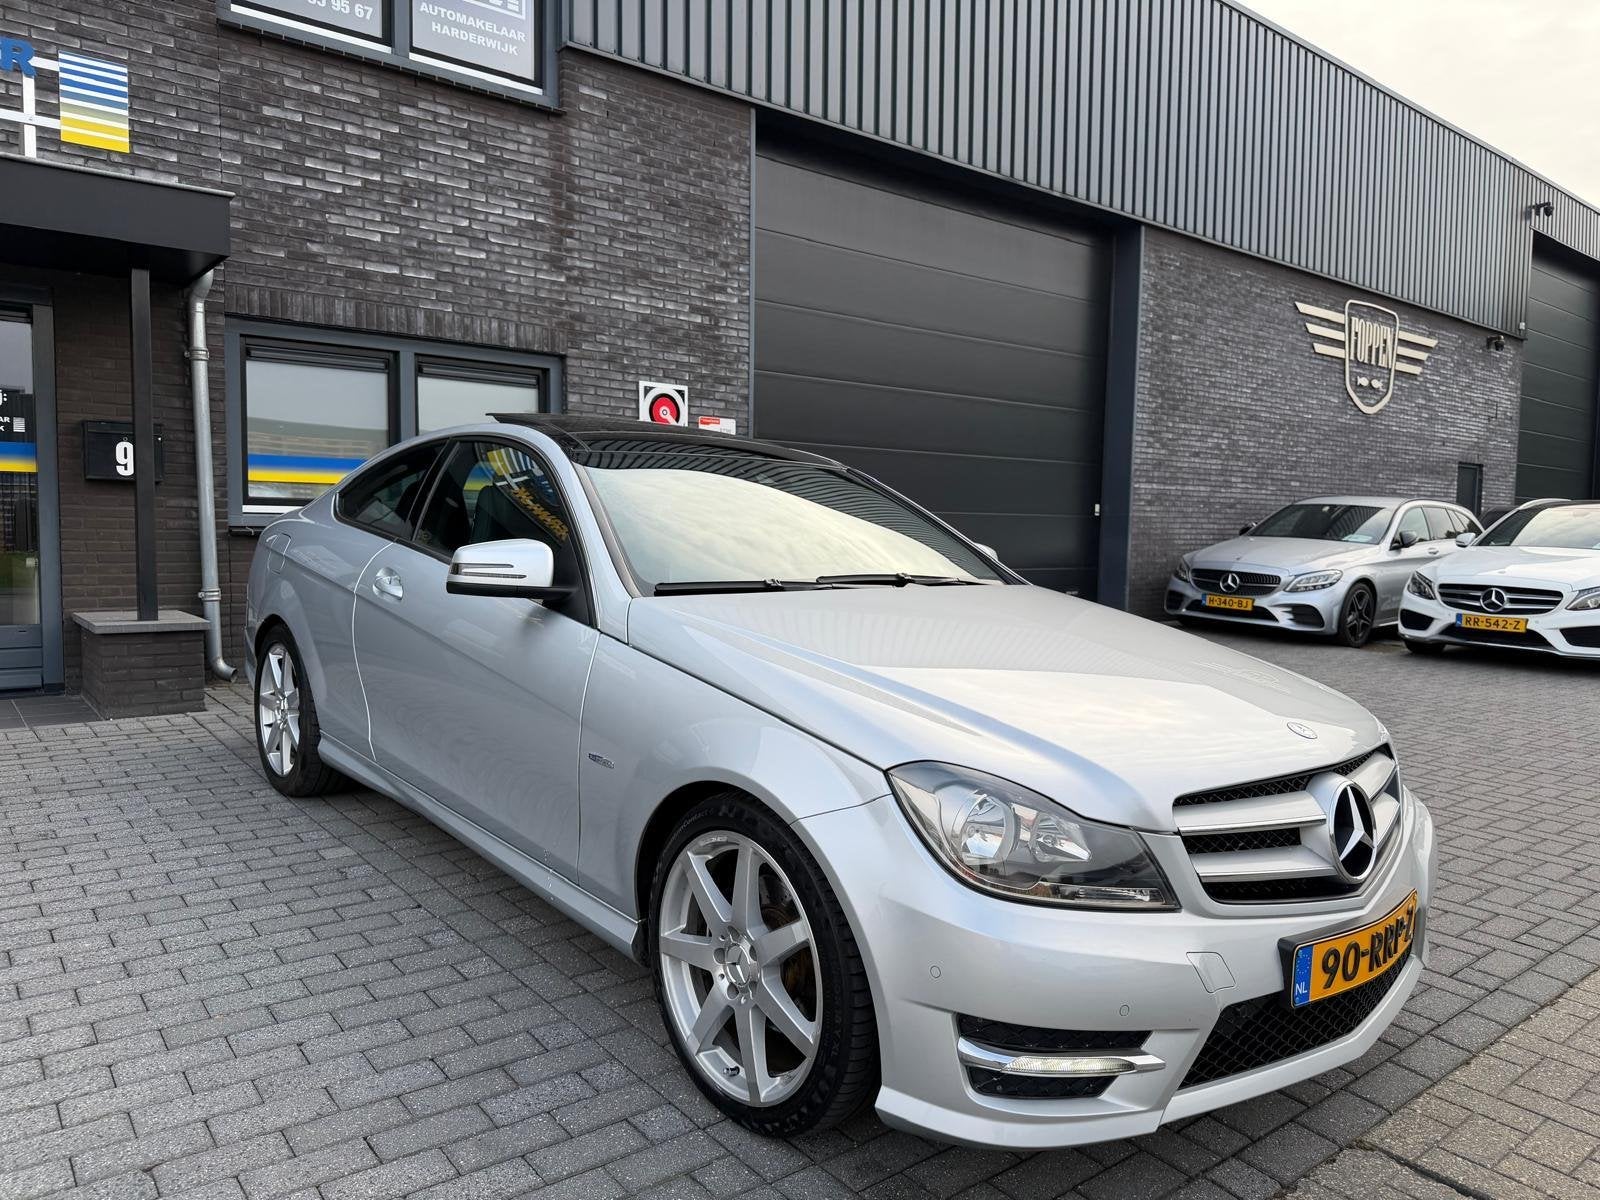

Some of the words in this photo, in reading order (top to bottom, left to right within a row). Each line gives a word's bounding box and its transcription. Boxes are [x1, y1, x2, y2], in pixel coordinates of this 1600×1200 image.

[354, 3, 373, 20] 67
[420, 2, 526, 42] AUTOMAKELAAR
[431, 21, 518, 55] HARDERWIJK
[1350, 316, 1394, 369] FOPPEN
[115, 441, 134, 476] 9
[1208, 596, 1249, 608] H-340-BJ
[1465, 616, 1521, 630] RR-542-Z
[1295, 981, 1308, 996] NL
